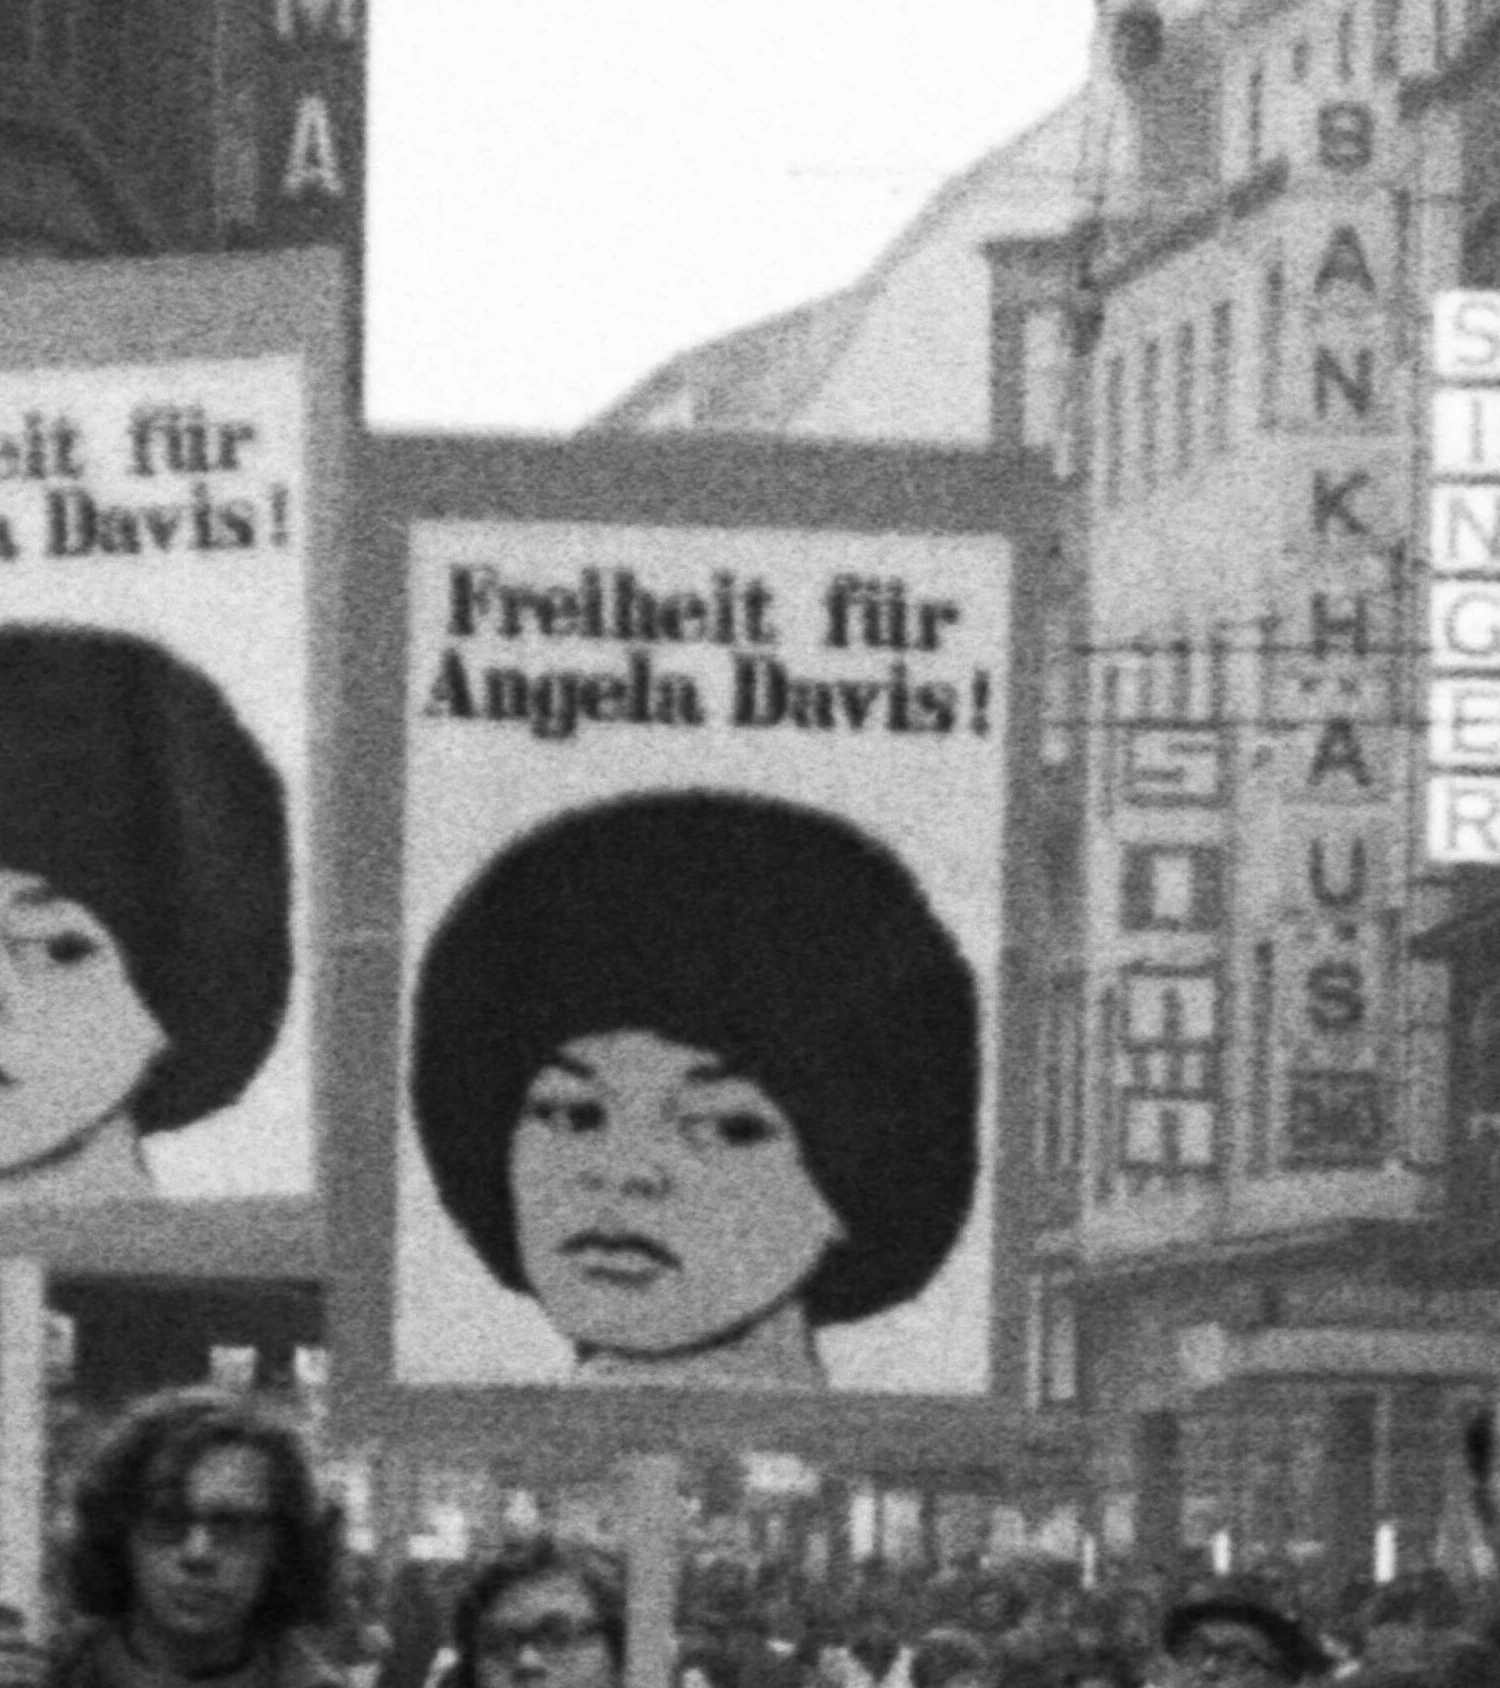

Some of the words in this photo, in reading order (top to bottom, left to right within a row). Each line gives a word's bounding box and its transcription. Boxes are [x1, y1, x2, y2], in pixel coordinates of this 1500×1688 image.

[131, 410, 255, 477] für
[48, 484, 285, 558] Davis!
[1308, 102, 1377, 1030] BANKHAUS
[450, 568, 773, 645] Freiheit
[826, 576, 959, 652] für
[428, 650, 704, 741] Angela
[733, 655, 989, 734] Davis!
